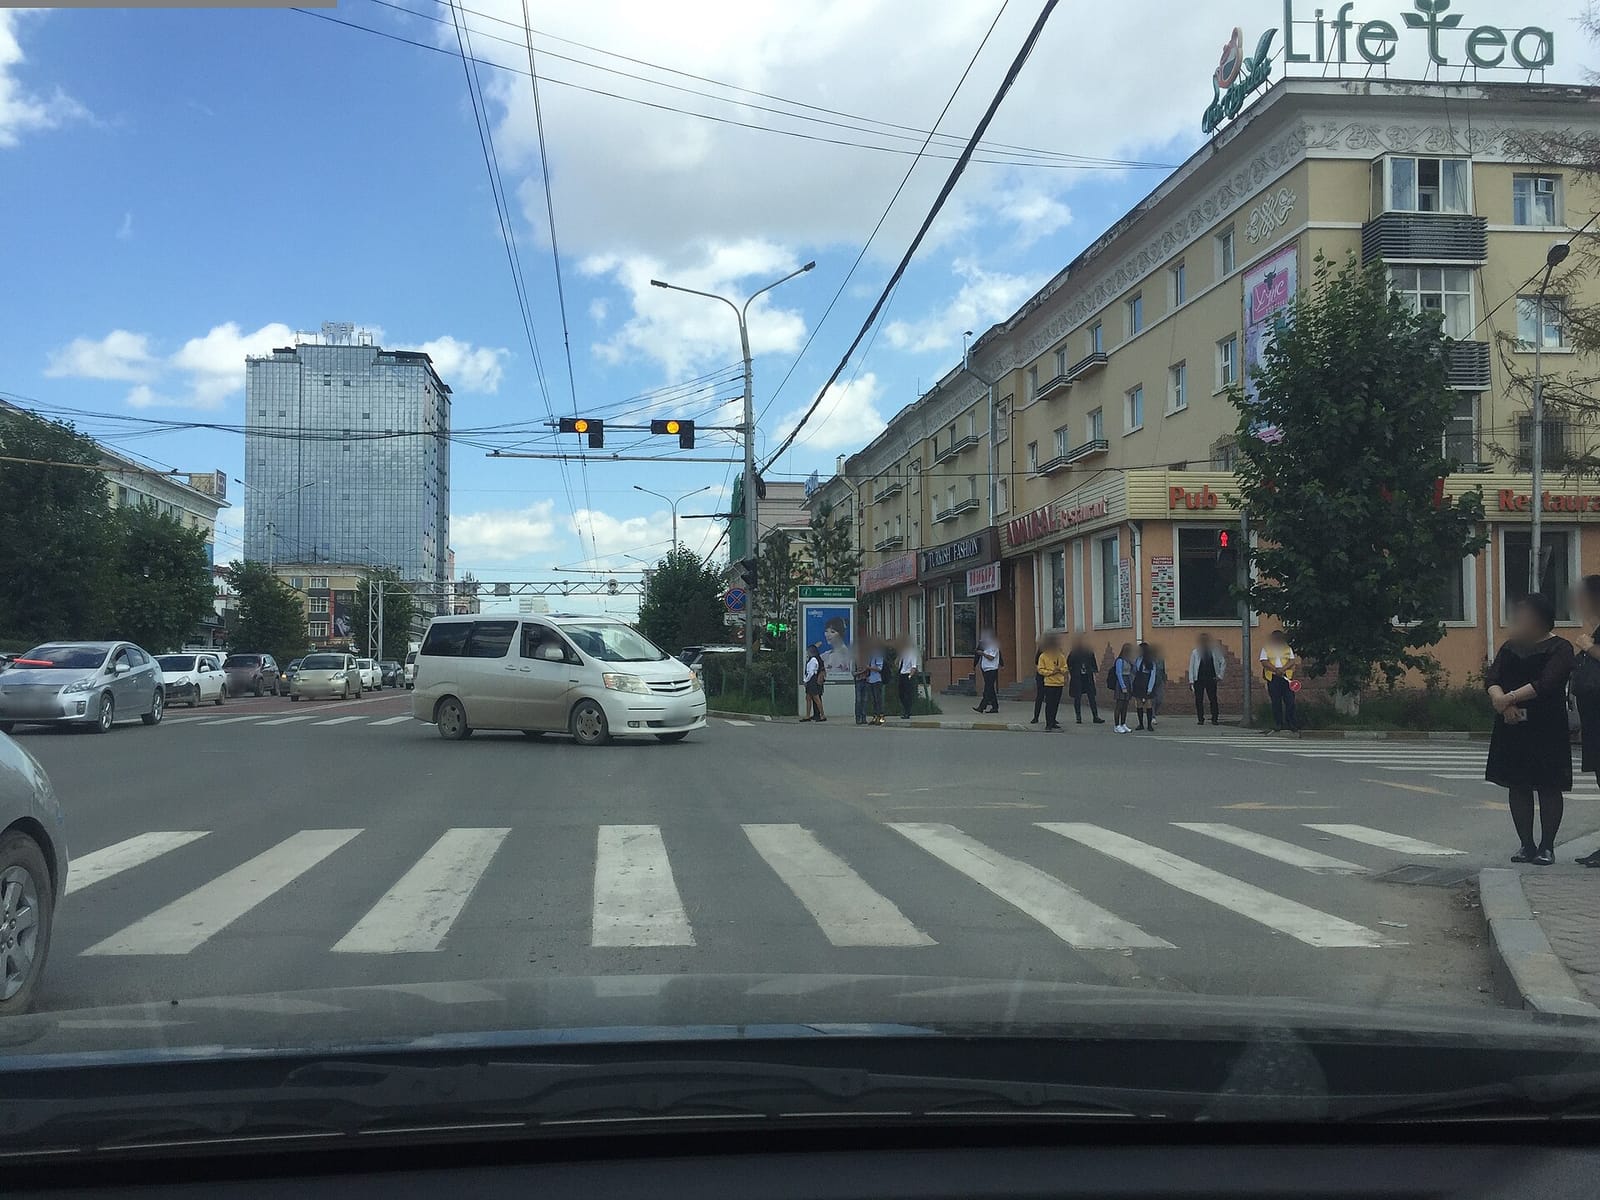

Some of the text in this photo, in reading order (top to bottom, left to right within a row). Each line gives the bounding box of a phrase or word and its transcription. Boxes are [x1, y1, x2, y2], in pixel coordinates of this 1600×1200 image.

[1284, 0, 1554, 69] Life tea
[1169, 484, 1218, 510] Pub
[1498, 489, 1600, 513] Retaura
